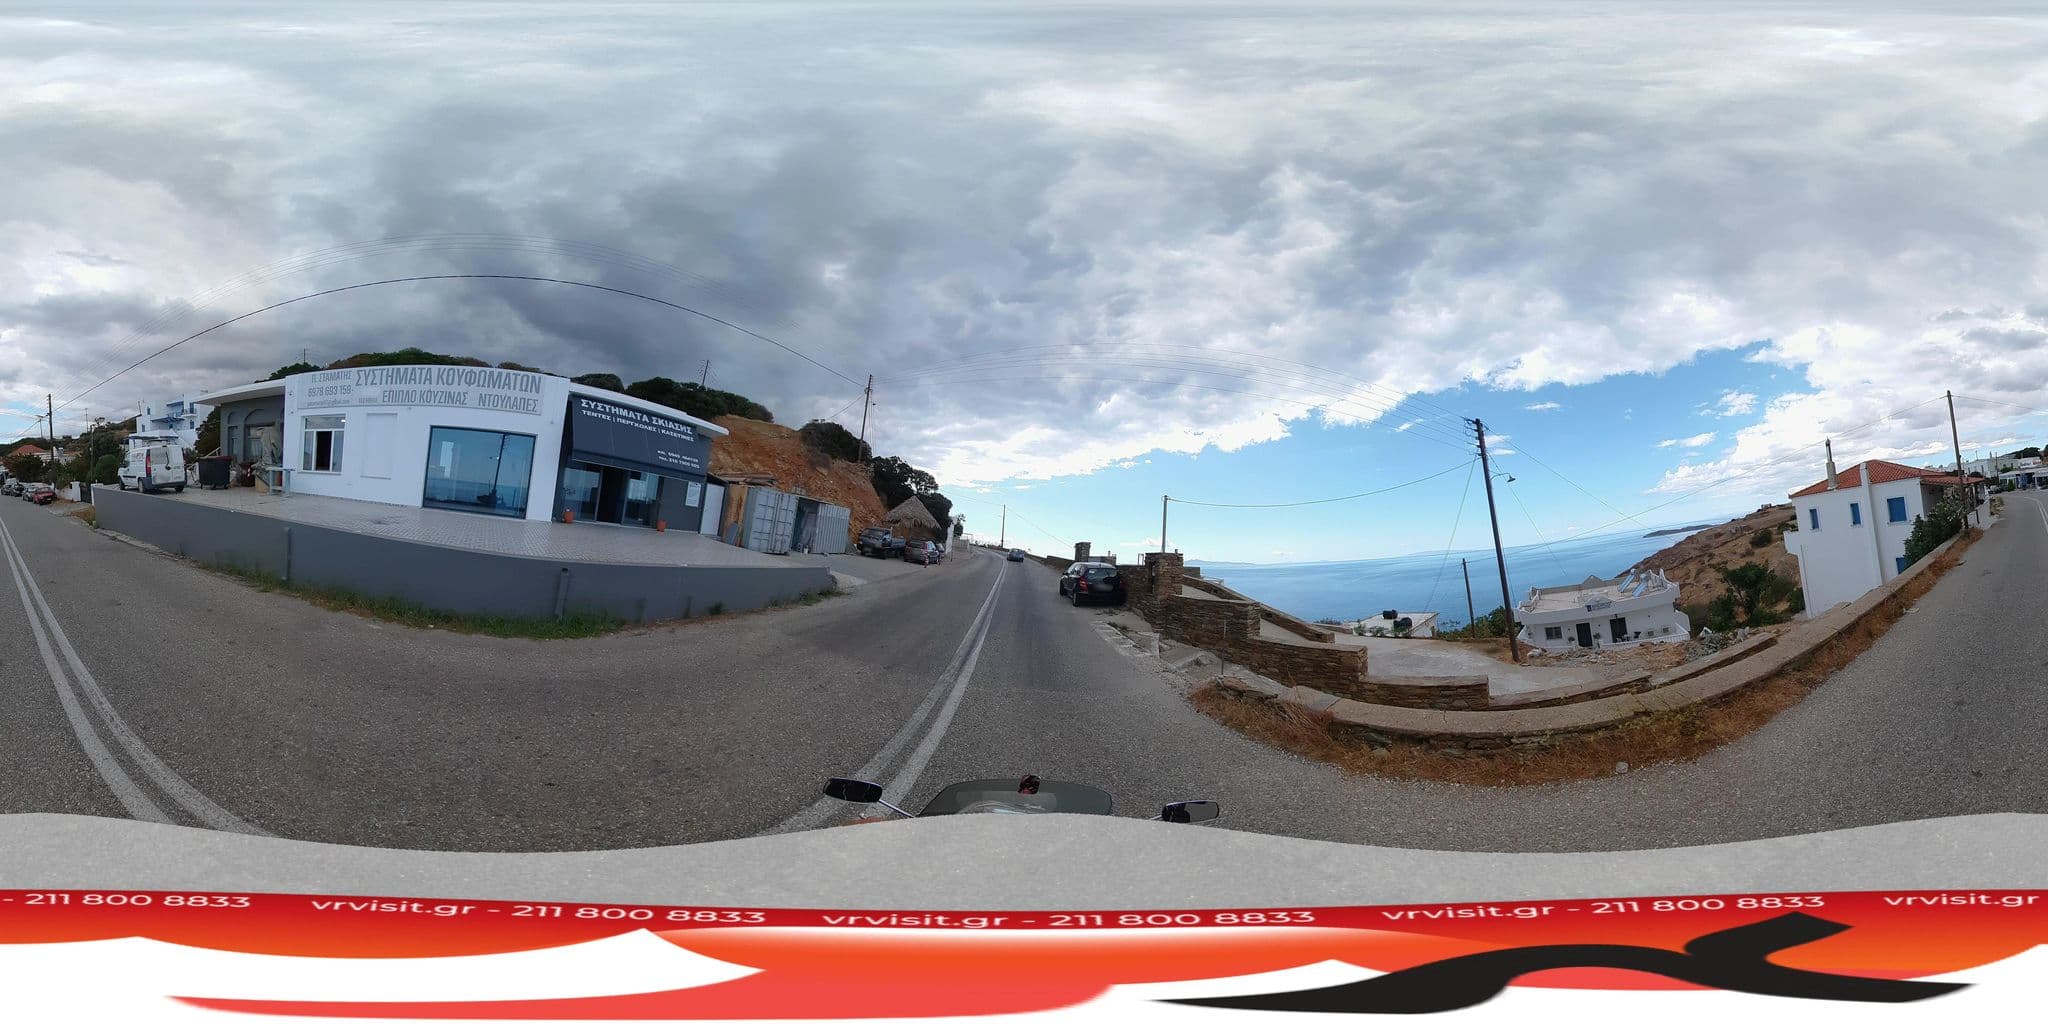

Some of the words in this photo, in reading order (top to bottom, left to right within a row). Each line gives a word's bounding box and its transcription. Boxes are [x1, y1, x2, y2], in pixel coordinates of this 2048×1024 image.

[355, 367, 432, 387] ΣΥΣΤΗΜΑΤΑ
[437, 368, 541, 393] ΚΟΥΦΩΜΑΤΩΝ
[382, 389, 417, 404] ΕΠΙΠΛΟ
[419, 389, 469, 406] ΚΟΥΖΙΝΑΣ
[478, 393, 539, 413] ΝΤΟΥΛΑΠΕΣ
[581, 399, 649, 423] ΣΥΣΤΗΜΑΤΑ
[652, 417, 693, 434] ΣΚΙΑΣΗΣ
[582, 410, 611, 421] ΤΕΝΤΕΣ
